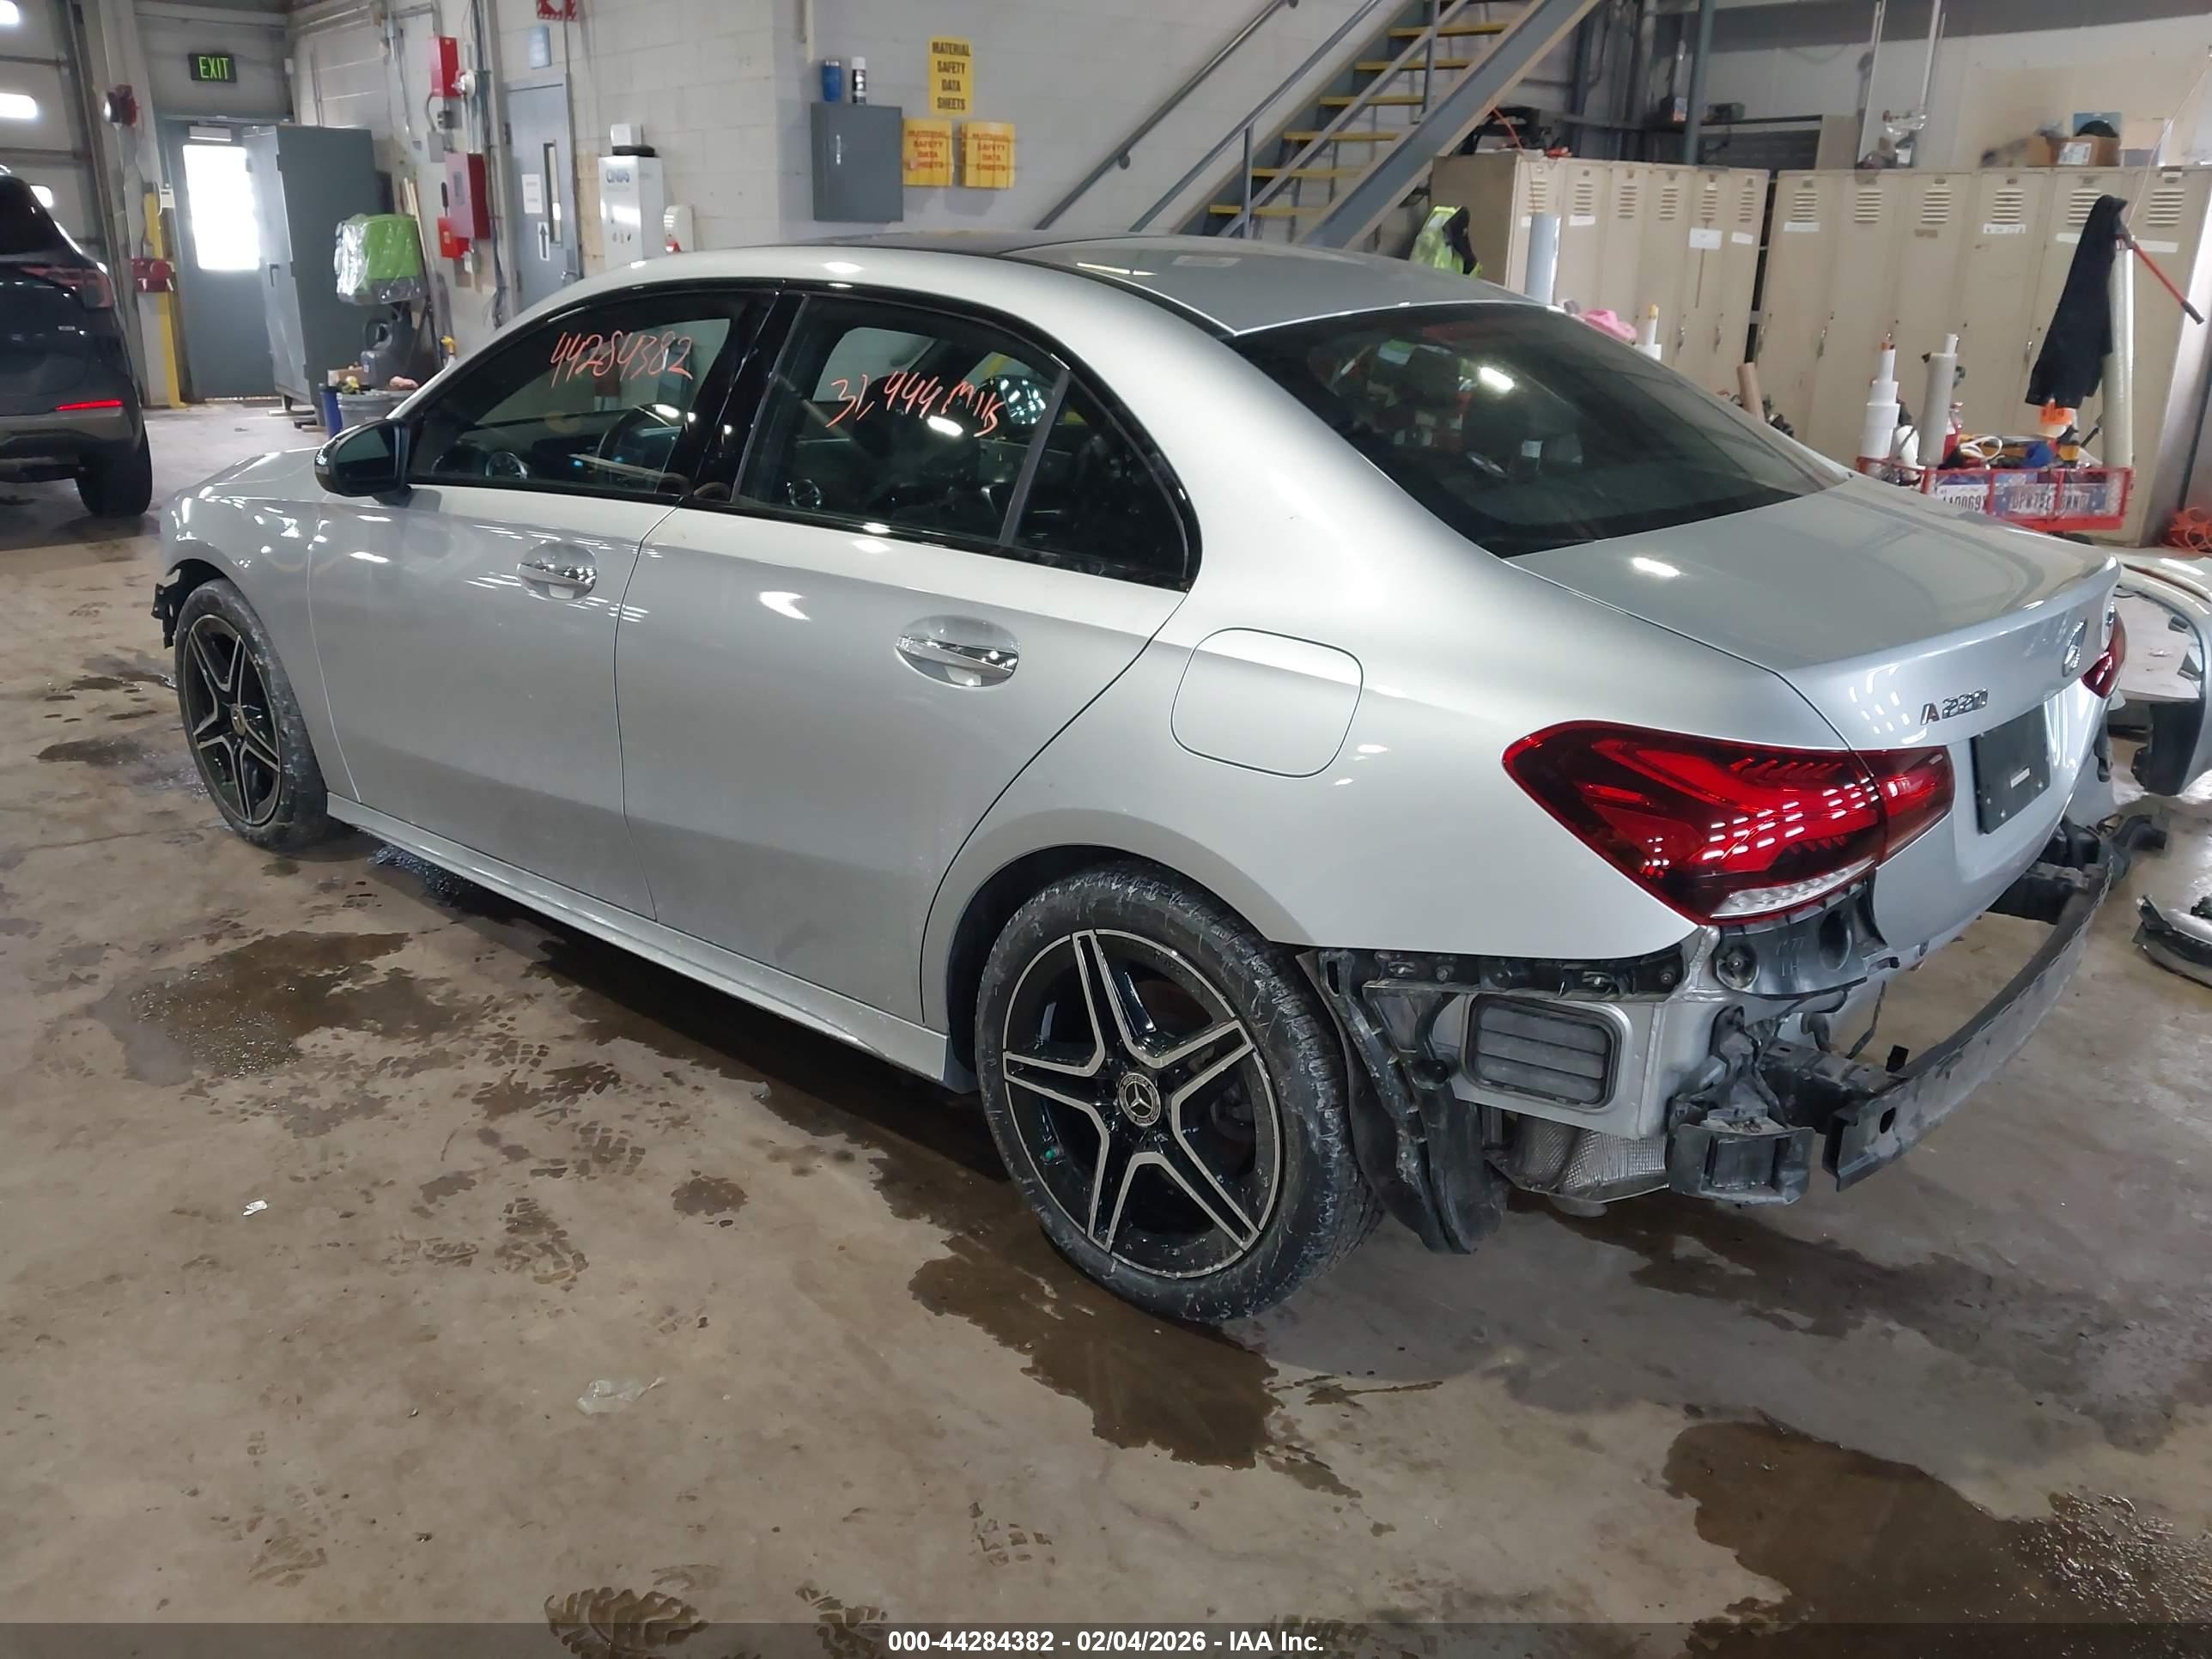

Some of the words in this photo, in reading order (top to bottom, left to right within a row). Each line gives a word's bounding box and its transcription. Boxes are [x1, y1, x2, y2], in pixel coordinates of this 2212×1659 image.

[933, 41, 969, 56] MATERIAL
[199, 57, 229, 79] EXIT
[937, 60, 965, 74] SAFETY
[942, 79, 961, 91] DATA
[937, 97, 965, 110] SHEETS
[550, 331, 693, 388] 44284382
[1920, 702, 1940, 726] A
[1942, 688, 1988, 720] 220
